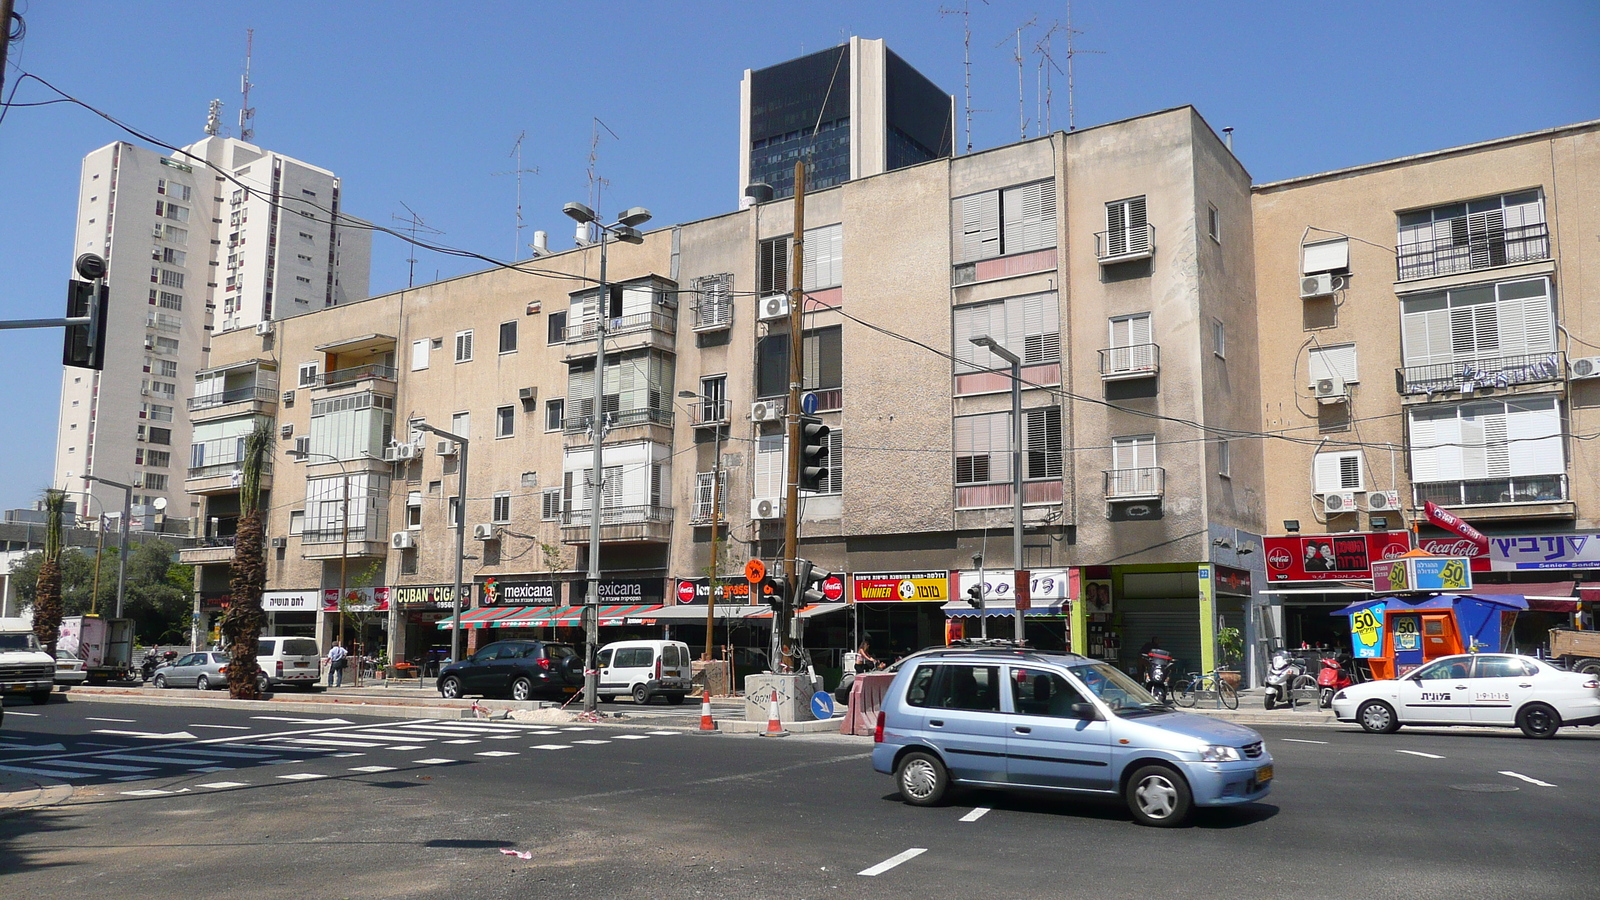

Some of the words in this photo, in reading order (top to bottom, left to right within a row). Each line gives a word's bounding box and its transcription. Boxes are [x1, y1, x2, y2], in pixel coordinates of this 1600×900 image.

[1335, 540, 1365, 555] השמן
[1424, 540, 1479, 556] Coca-Cola
[1337, 555, 1366, 568] והרזה
[1391, 565, 1405, 584] 50
[1443, 562, 1464, 582] 50
[397, 587, 429, 602] CUBAN
[433, 586, 470, 602] CIGAS
[504, 583, 553, 597] mexicana
[598, 581, 641, 595] exicana
[696, 584, 749, 598] lemngrass
[861, 582, 892, 599] WINNER
[916, 585, 940, 598] טוטו
[269, 597, 289, 607] תושיה
[290, 595, 304, 606] לחם
[1354, 613, 1374, 629] 50
[1399, 621, 1415, 634] 50
[1420, 692, 1451, 701] מונית
